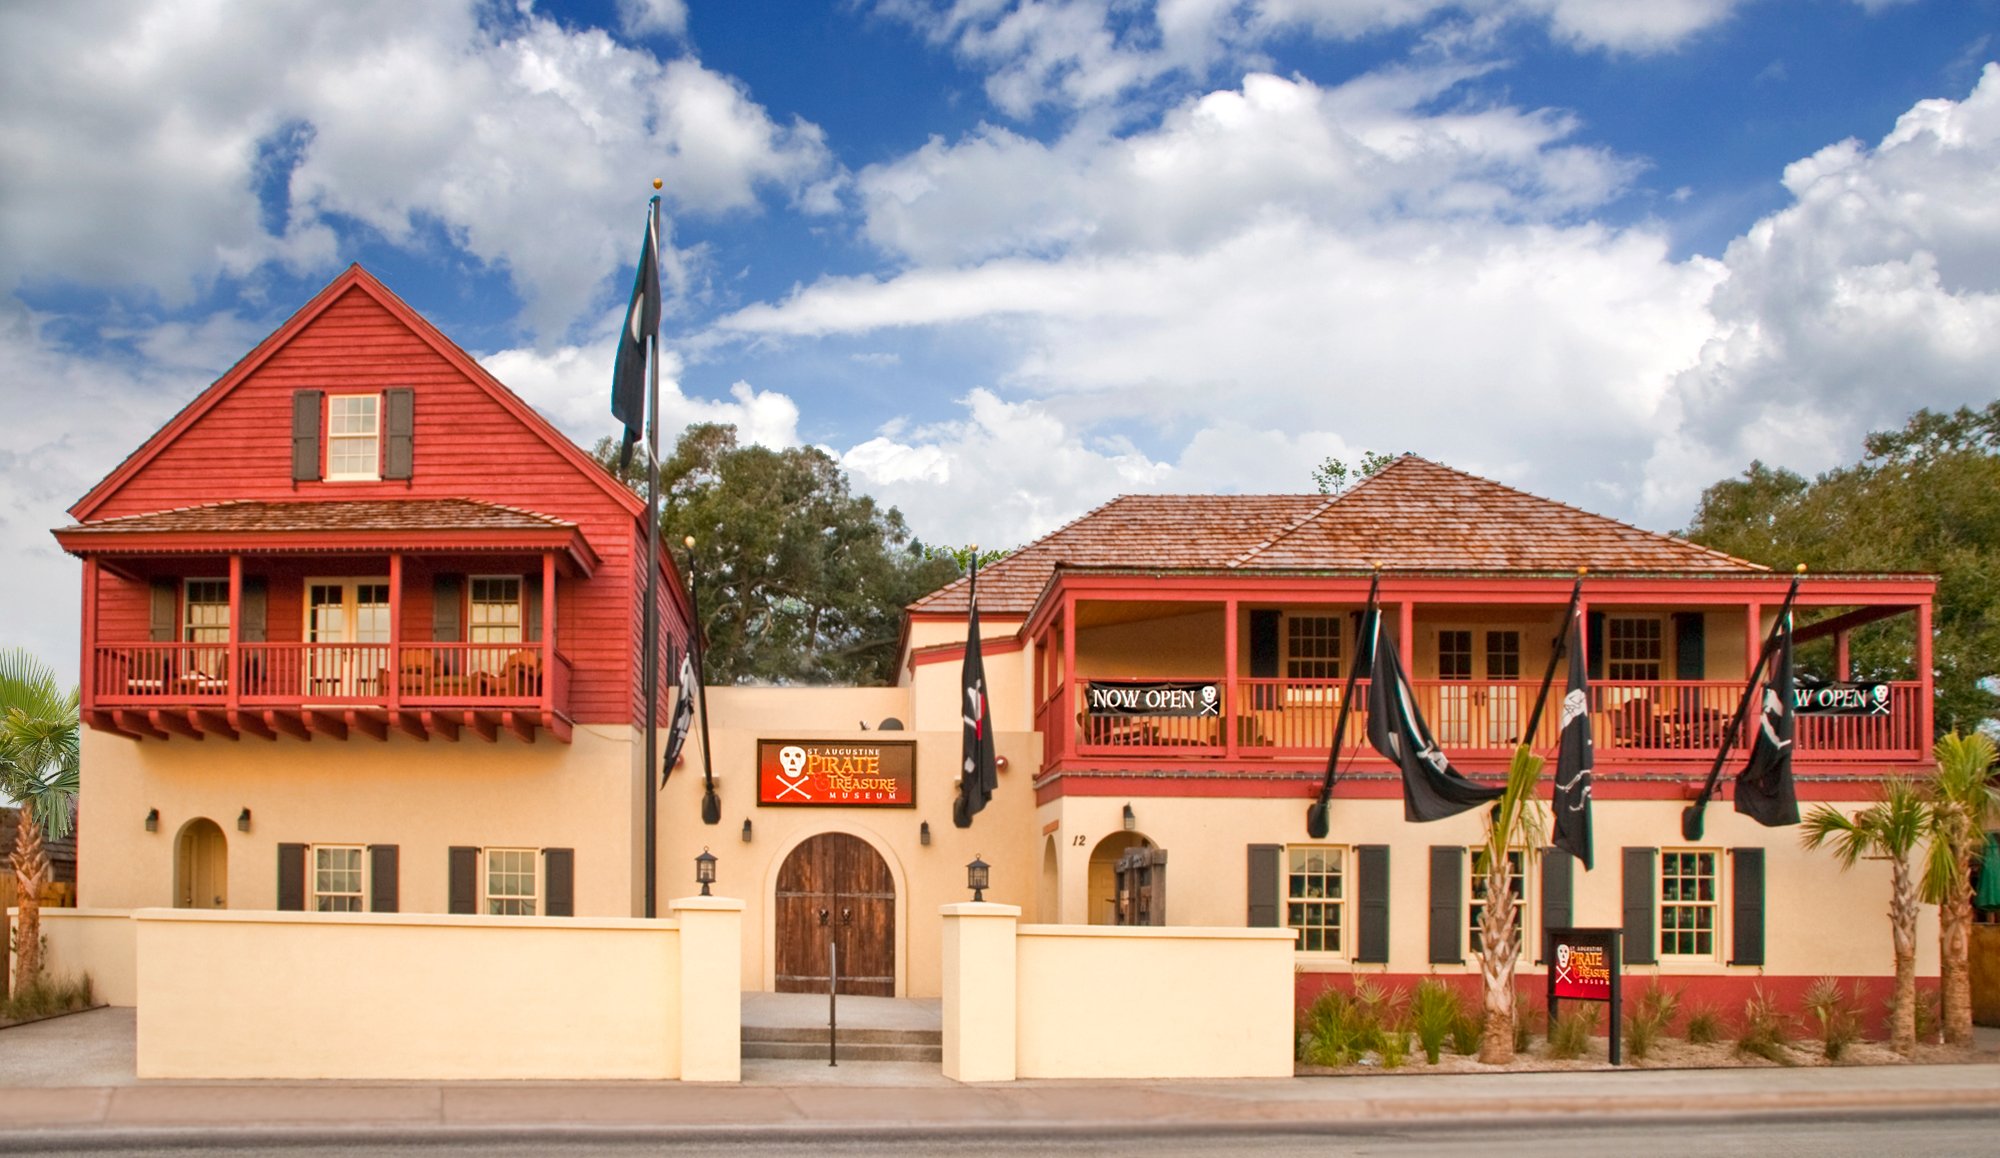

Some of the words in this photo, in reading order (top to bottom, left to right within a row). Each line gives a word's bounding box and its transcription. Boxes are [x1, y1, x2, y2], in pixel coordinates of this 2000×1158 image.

[1093, 689, 1140, 708] NOW
[1145, 689, 1195, 709] OPEN
[1818, 688, 1867, 708] OPEN
[806, 755, 880, 778] PIRATE
[828, 774, 896, 792] TREASURE
[829, 792, 896, 800] MUSEUM
[1072, 834, 1086, 846] 12
[1570, 950, 1602, 970] PIRATE
